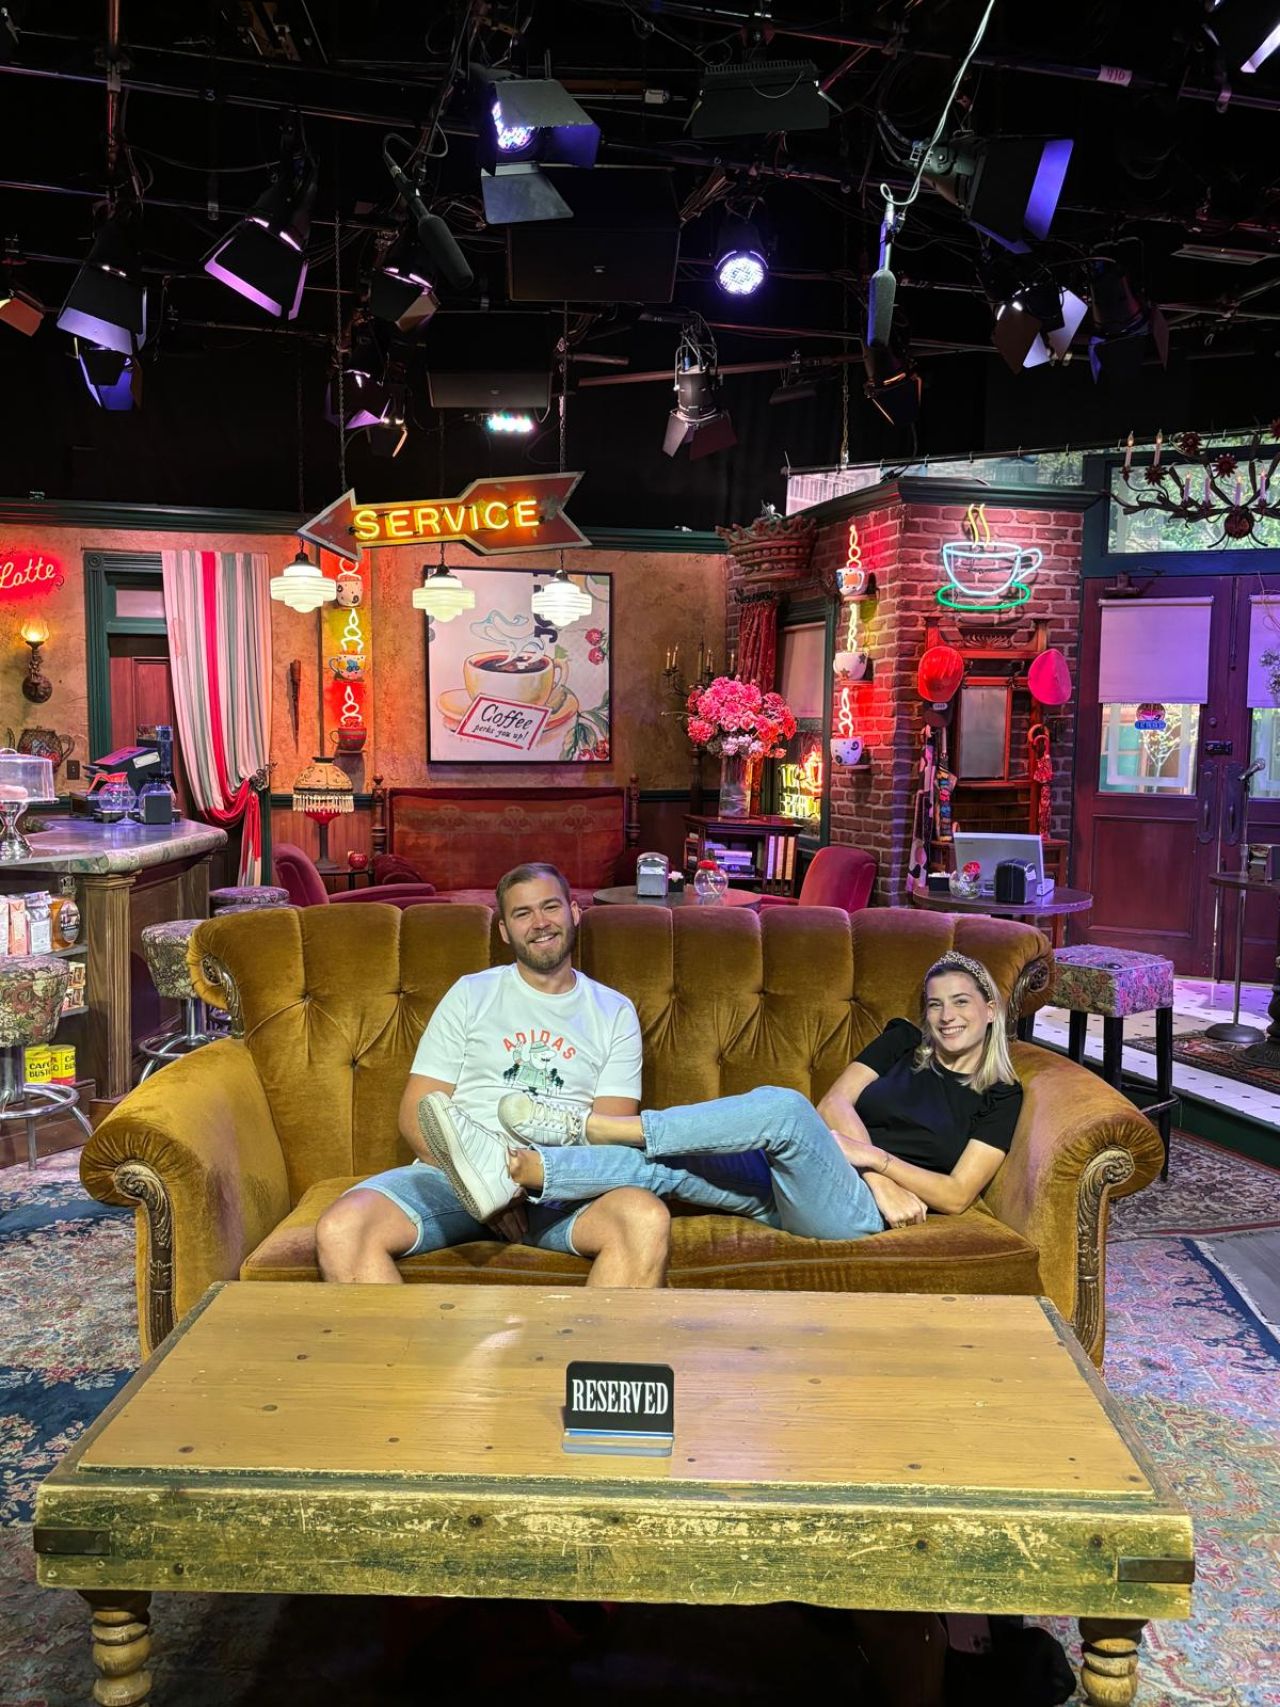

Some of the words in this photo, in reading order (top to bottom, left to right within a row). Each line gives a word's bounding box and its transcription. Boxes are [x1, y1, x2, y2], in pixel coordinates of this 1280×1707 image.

[354, 500, 540, 540] SERVICE
[0, 556, 56, 589] Latte
[481, 703, 533, 730] Coffee
[471, 724, 495, 734] perks
[495, 730, 511, 738] you
[512, 731, 529, 742] up!
[503, 1029, 576, 1060] ADIDAS
[572, 1379, 669, 1415] RESERVED
